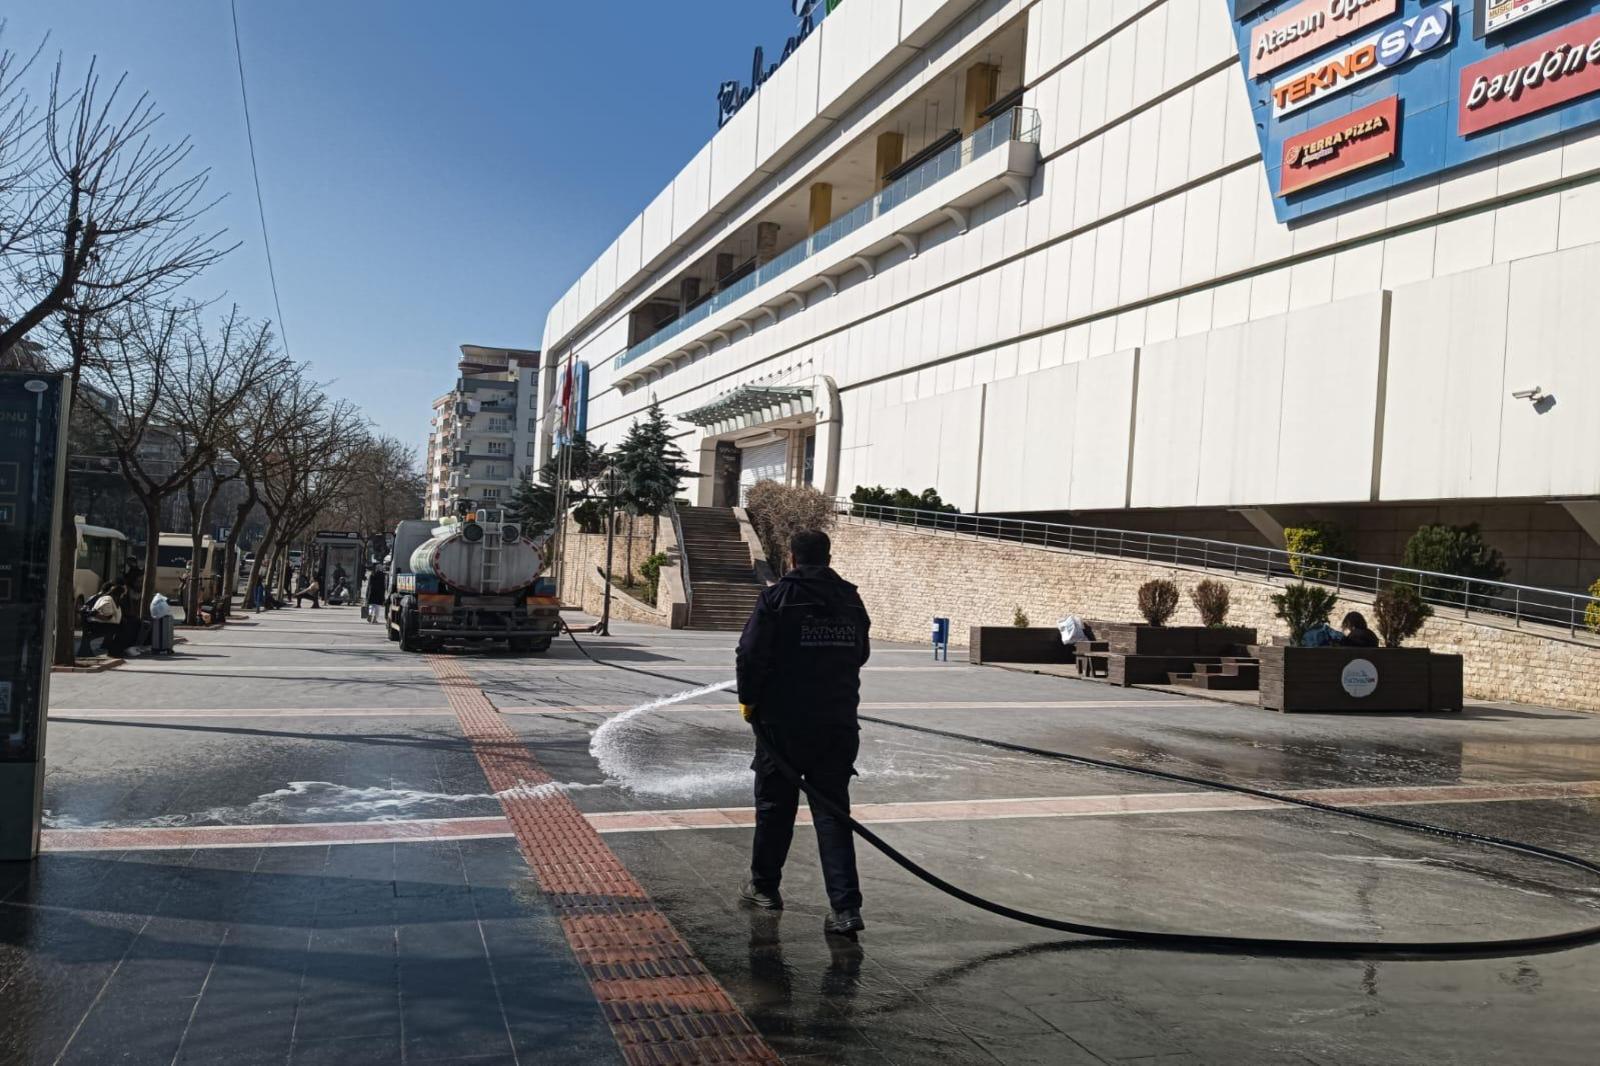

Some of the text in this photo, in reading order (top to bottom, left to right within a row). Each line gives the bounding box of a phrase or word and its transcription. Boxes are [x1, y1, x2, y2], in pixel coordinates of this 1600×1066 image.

[1488, 4, 1512, 17] MUSIC
[1257, 10, 1322, 56] Atasun
[1273, 12, 1444, 108] TEKNOSA
[1303, 132, 1342, 156] TERRA
[800, 624, 856, 635] BATMAN
